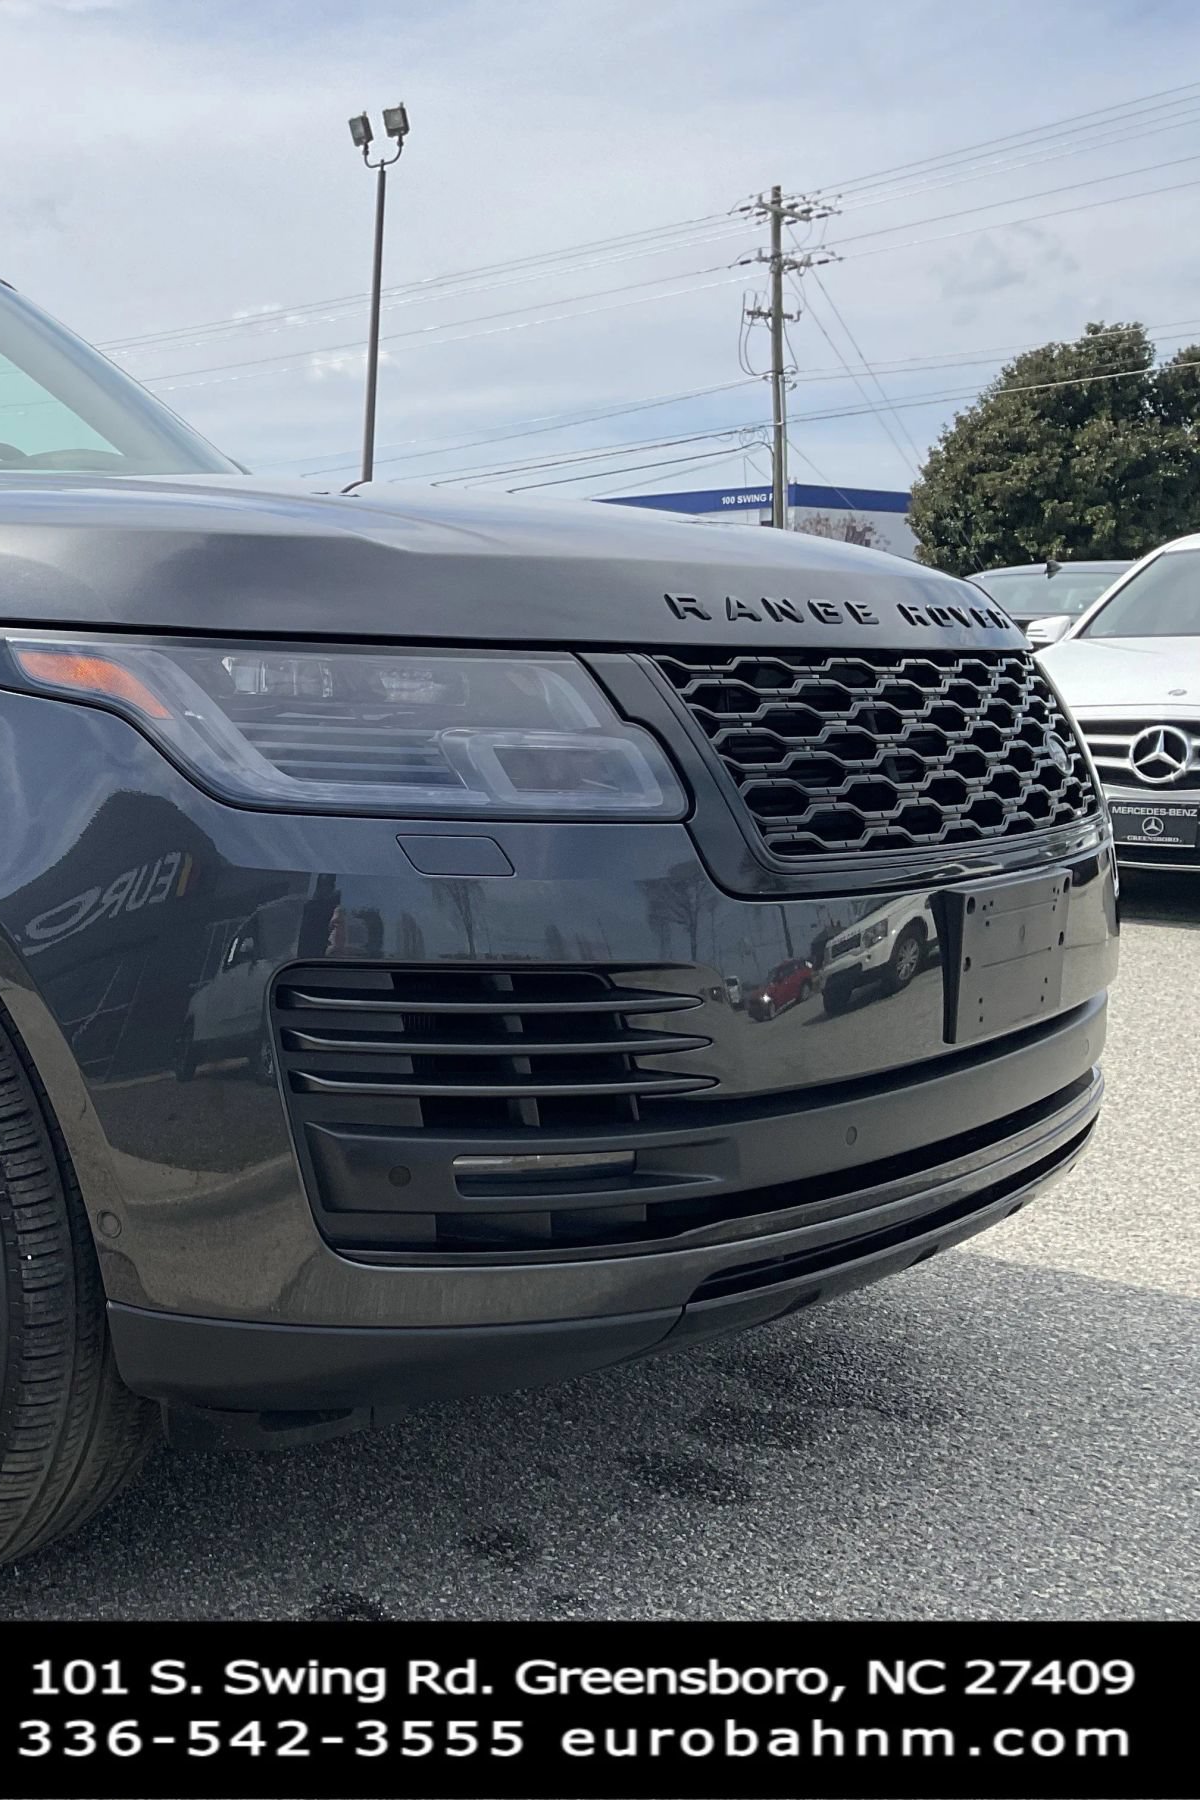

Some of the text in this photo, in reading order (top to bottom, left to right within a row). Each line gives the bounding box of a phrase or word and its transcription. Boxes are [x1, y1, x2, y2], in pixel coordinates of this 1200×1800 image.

[721, 495, 736, 505] 100
[737, 493, 767, 504] SWING
[663, 592, 1011, 631] RANGE ROVER
[1111, 806, 1198, 817] MERCEDES-BENZ
